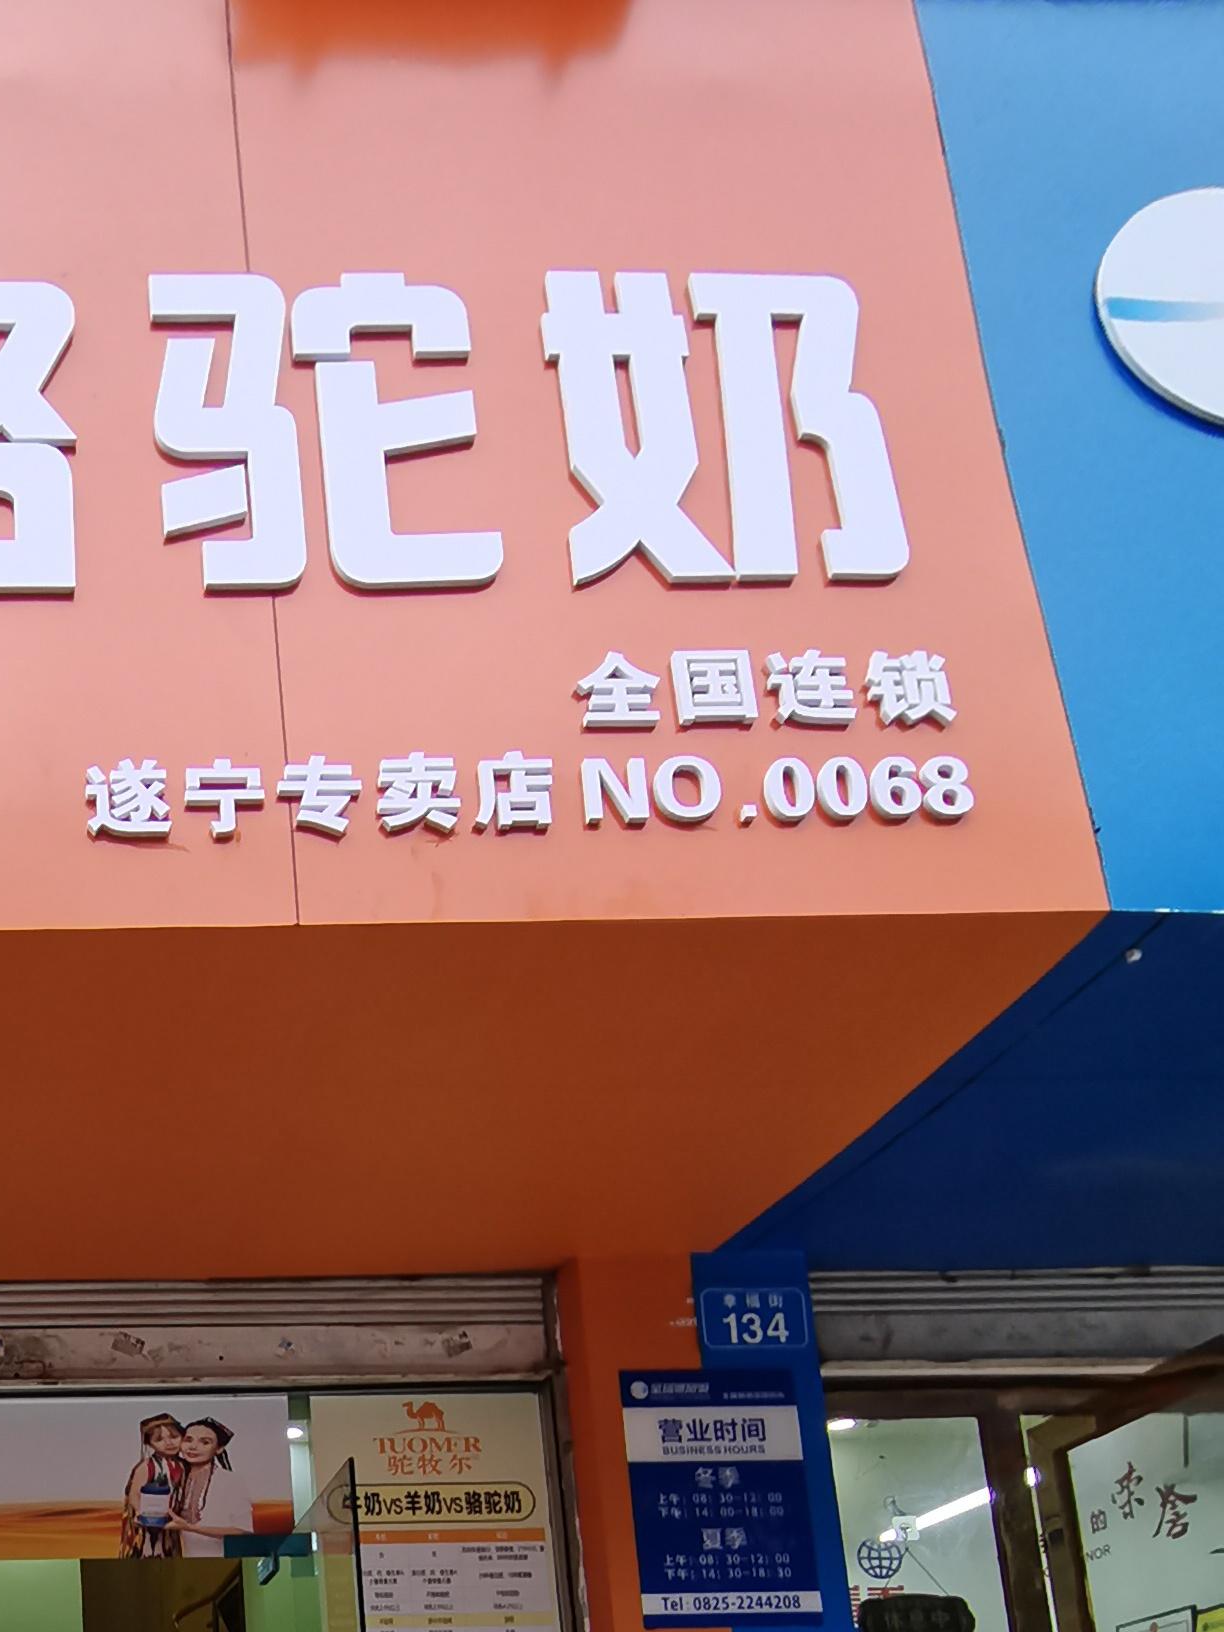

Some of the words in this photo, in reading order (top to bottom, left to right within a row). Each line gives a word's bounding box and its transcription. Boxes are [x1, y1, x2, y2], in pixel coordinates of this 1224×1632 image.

[575, 649, 957, 729] 全国连锁
[84, 751, 554, 839] 遂宁专卖店
[722, 1312, 790, 1344] 134
[658, 1418, 767, 1443] 营业时间
[662, 1446, 722, 1456] BUSINESS
[724, 1445, 766, 1455] HOURS
[387, 1454, 473, 1477] 驼牧尔
[701, 1527, 748, 1550] 夏季
